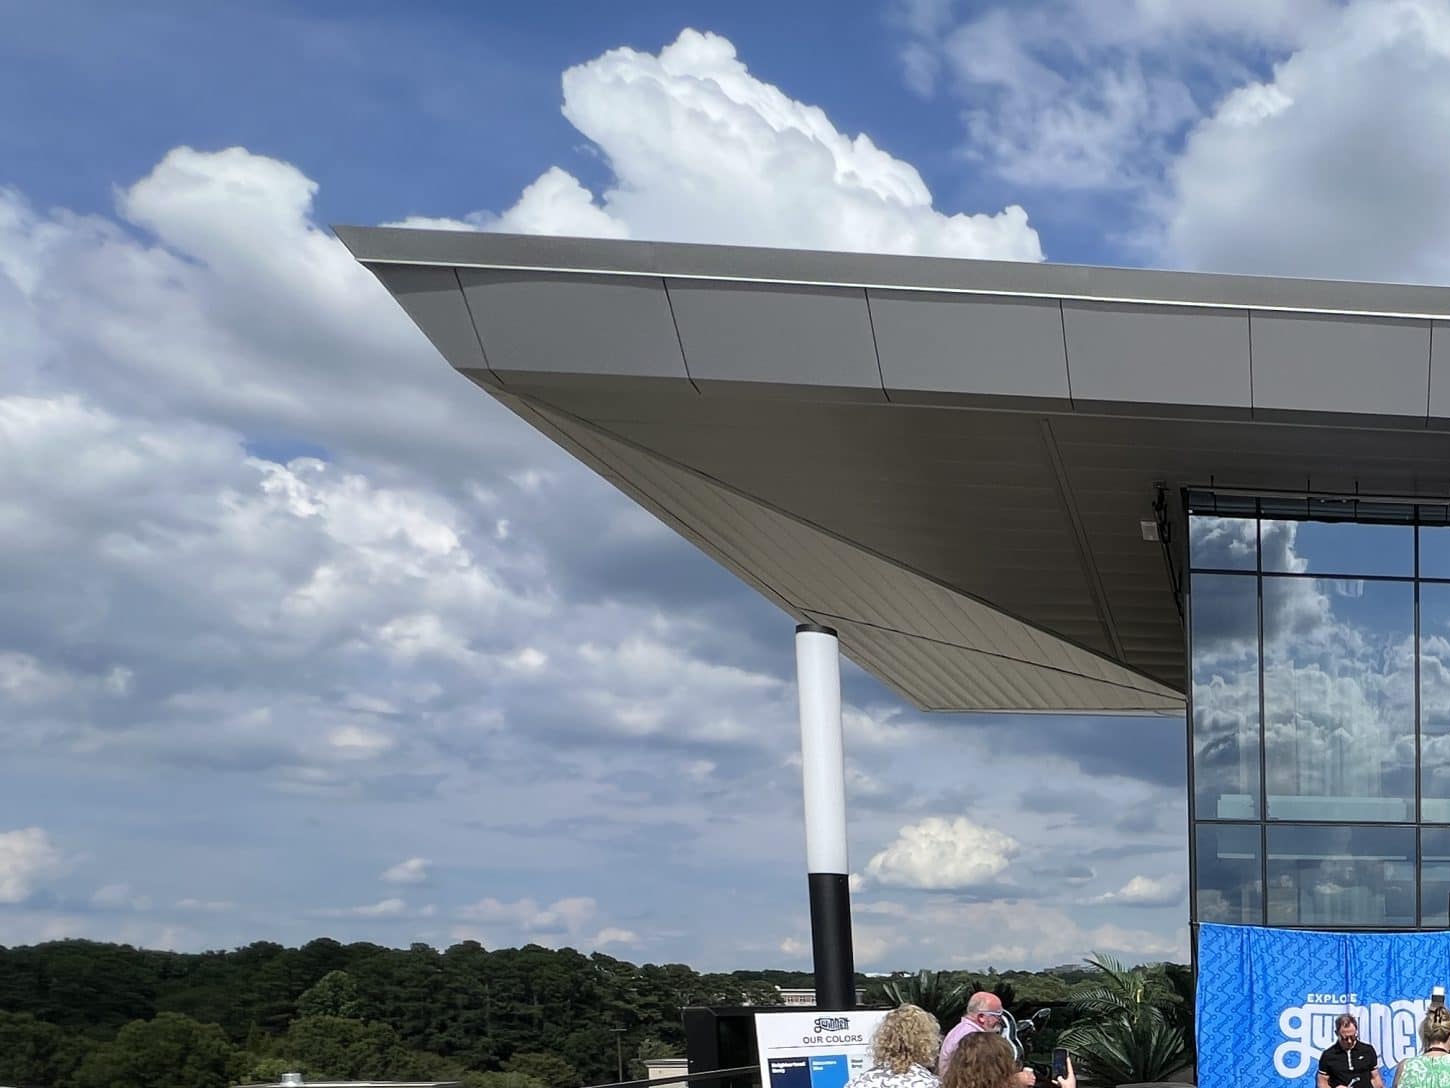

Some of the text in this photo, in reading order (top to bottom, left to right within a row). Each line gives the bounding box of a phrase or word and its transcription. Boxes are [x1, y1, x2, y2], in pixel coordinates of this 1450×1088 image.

[1307, 993, 1358, 1004] EXPLOE
[803, 1034, 863, 1044] OUR COLORS
